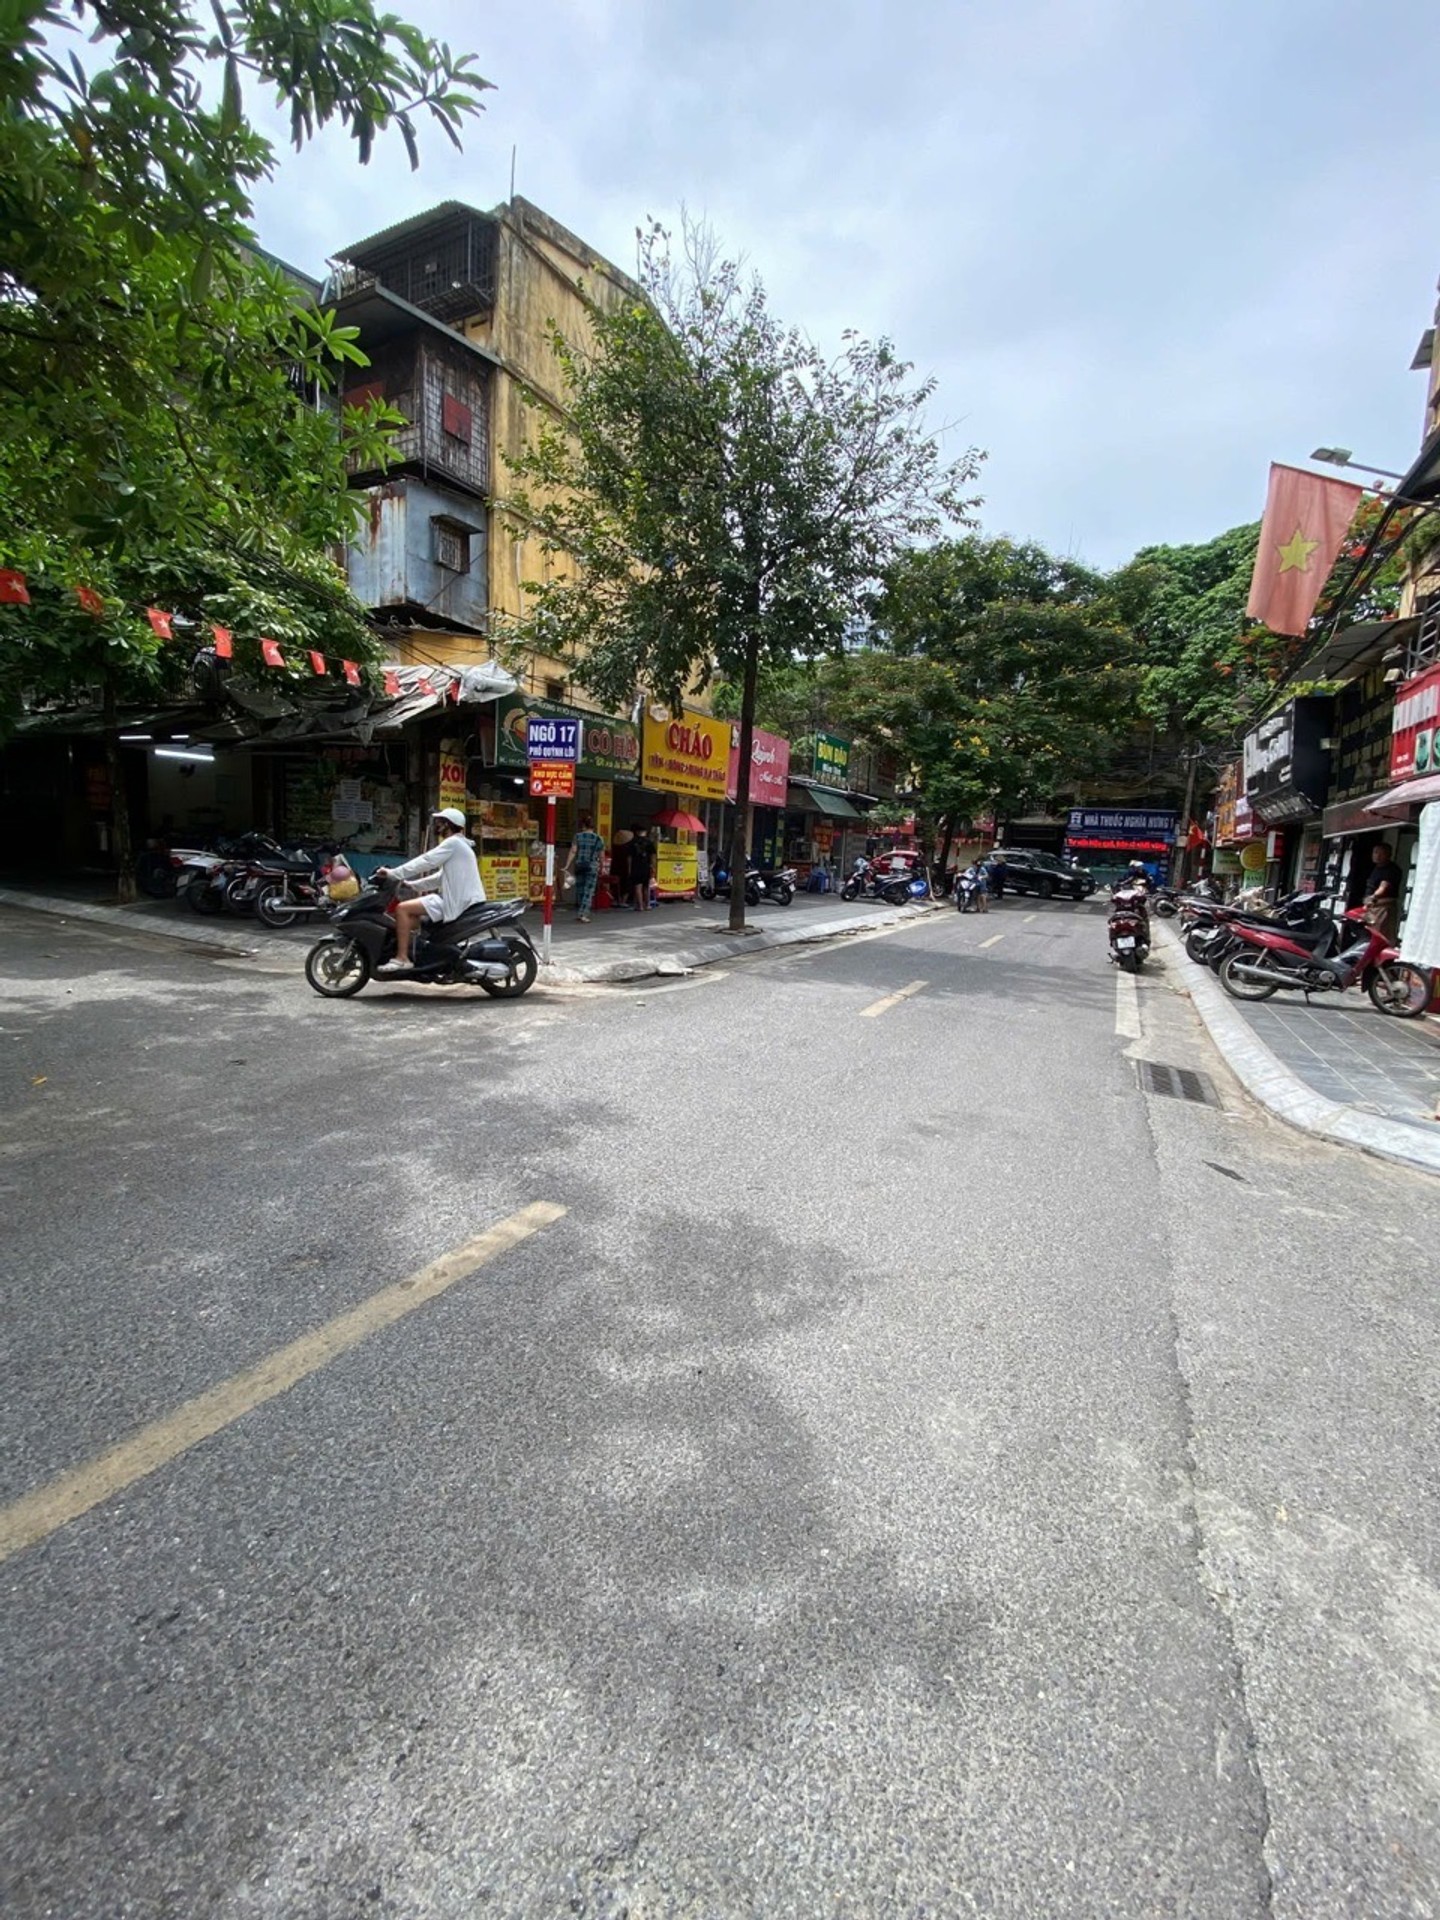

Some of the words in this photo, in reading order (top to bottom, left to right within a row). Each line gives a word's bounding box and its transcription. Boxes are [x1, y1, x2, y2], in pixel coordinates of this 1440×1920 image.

[529, 723, 556, 742] NGÕ
[560, 726, 576, 742] 17
[588, 728, 611, 755] CÔ
[668, 721, 713, 760] CHÁO
[529, 744, 542, 756] PHỐ
[543, 745, 564, 757] QUỲNH
[1084, 812, 1099, 826] NHÀ
[1099, 812, 1123, 826] THUỐC
